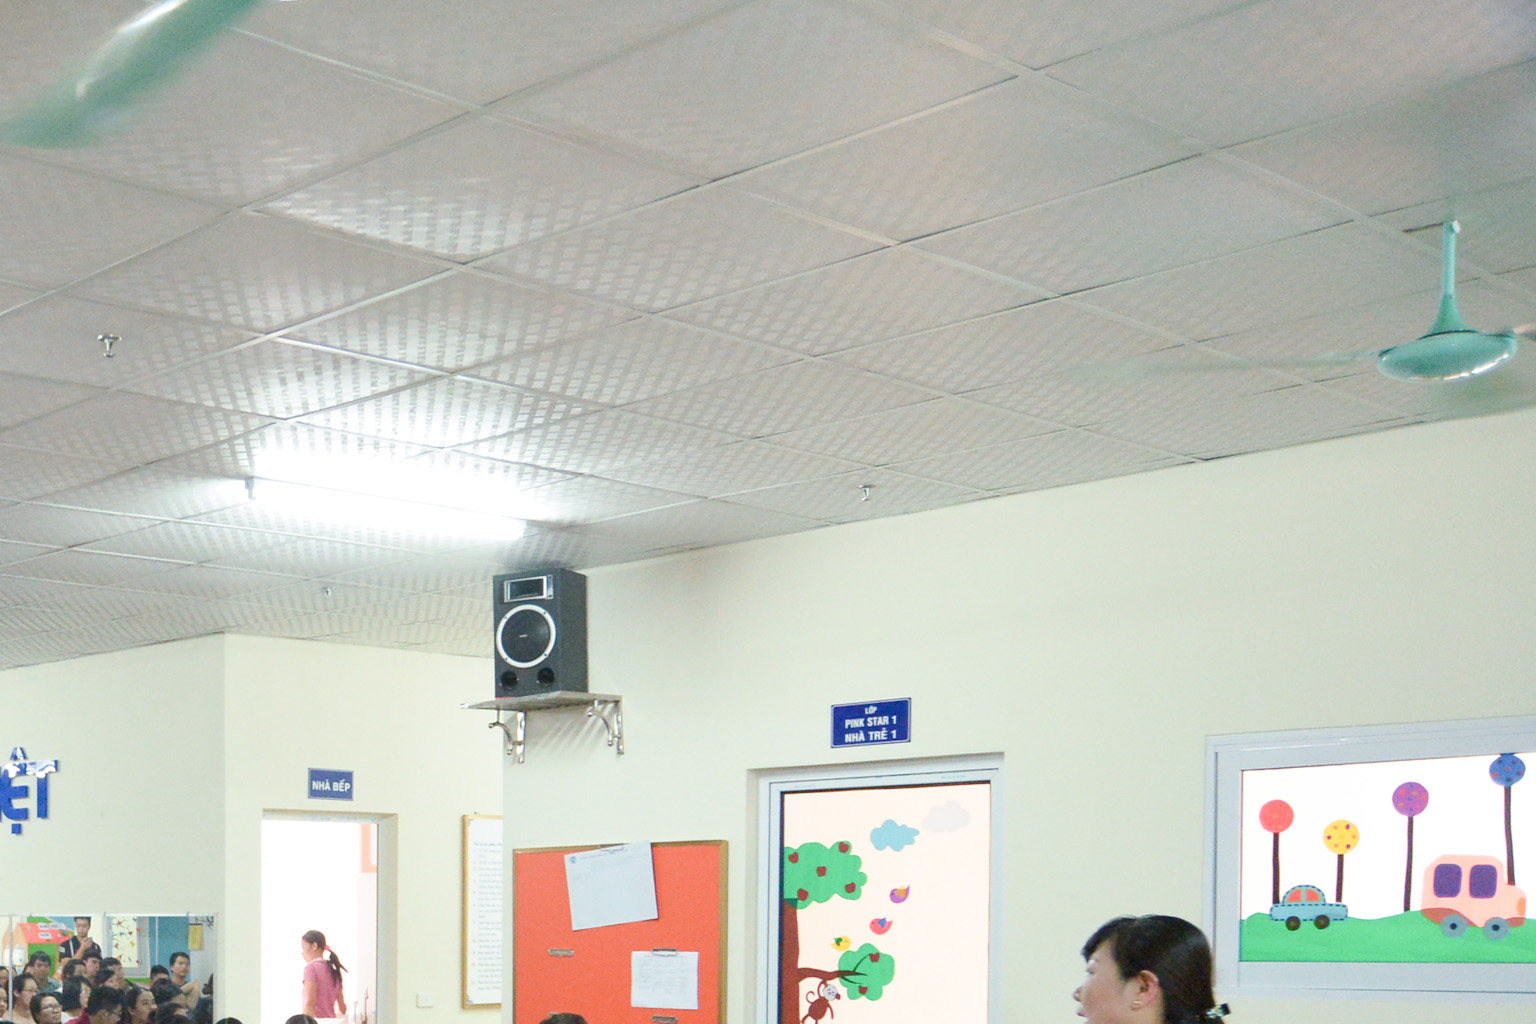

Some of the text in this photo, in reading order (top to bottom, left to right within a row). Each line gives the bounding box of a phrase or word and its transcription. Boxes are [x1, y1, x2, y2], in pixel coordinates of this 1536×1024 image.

[845, 715, 897, 729] PINK STAR 1
[845, 727, 897, 743] NHÀ TRẺ 1
[312, 778, 351, 792] NHÀ BẾP
